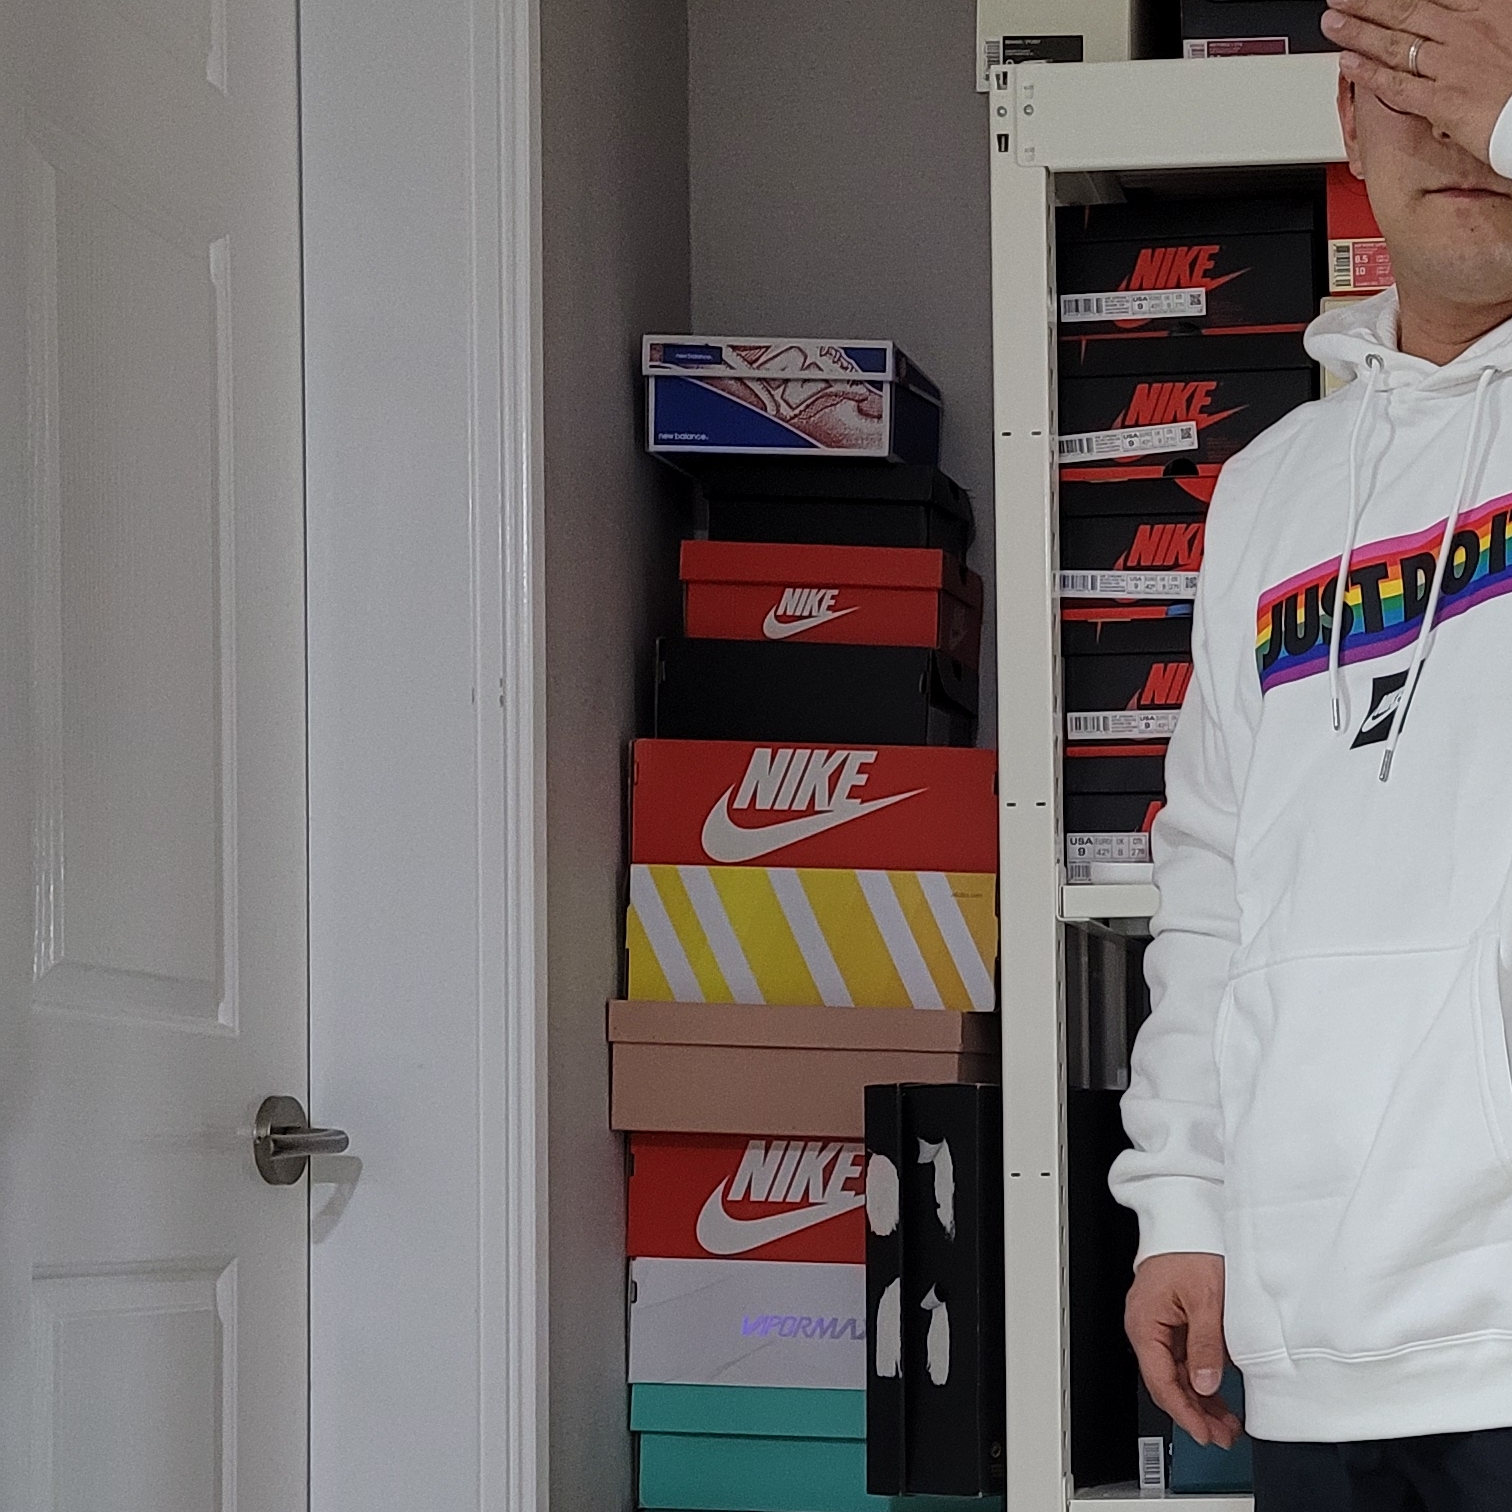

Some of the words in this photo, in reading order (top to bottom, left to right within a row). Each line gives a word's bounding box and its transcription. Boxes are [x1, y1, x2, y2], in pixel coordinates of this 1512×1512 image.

[1131, 245, 1220, 290] NIKE
[1355, 266, 1366, 276] 10
[1124, 381, 1217, 426] NIKE
[1122, 432, 1139, 440] USA
[776, 587, 840, 617] NIKE
[1262, 563, 1389, 671] JUST
[1400, 529, 1480, 623] DO
[732, 747, 879, 812] NIKE
[1069, 837, 1093, 845] USA
[1077, 847, 1086, 857] 9
[1117, 848, 1124, 856] 8
[727, 1139, 866, 1203] NIKE
